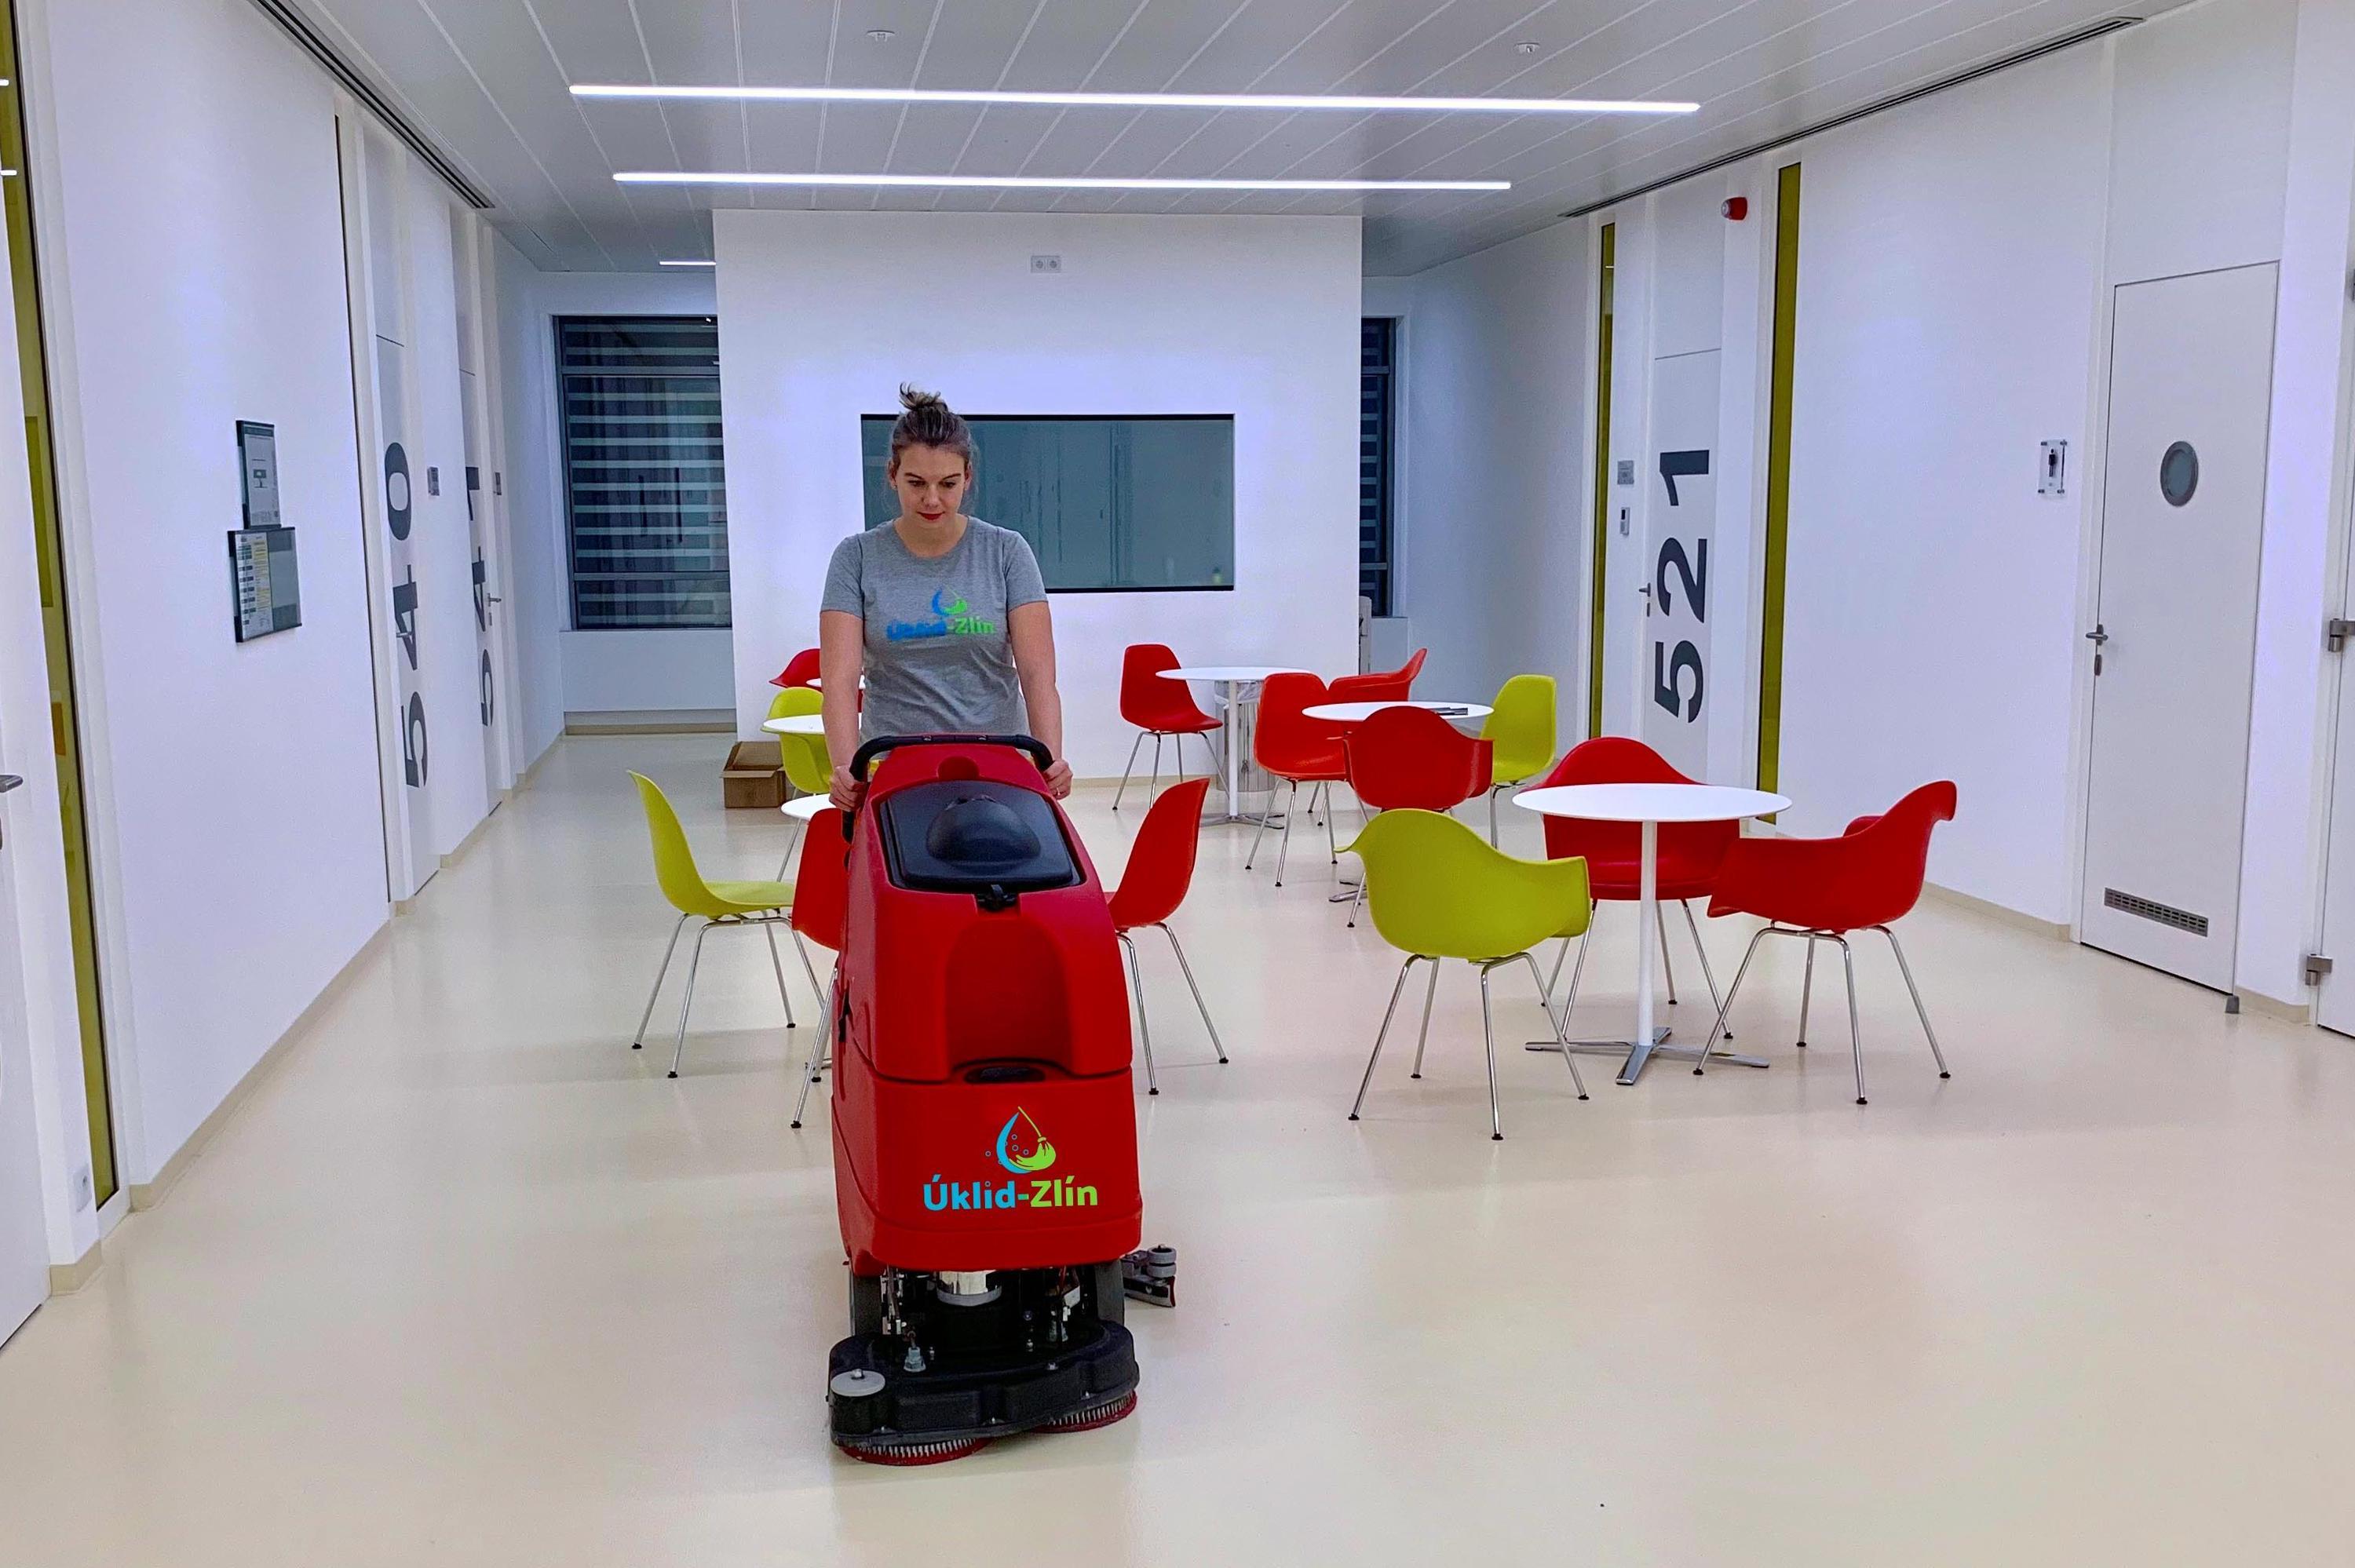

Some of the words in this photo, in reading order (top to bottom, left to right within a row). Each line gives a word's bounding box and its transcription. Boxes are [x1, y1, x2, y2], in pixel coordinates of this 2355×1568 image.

[385, 442, 428, 787] 540
[1654, 450, 1710, 723] 521
[923, 1174, 1098, 1211] Úklid-Zlín
